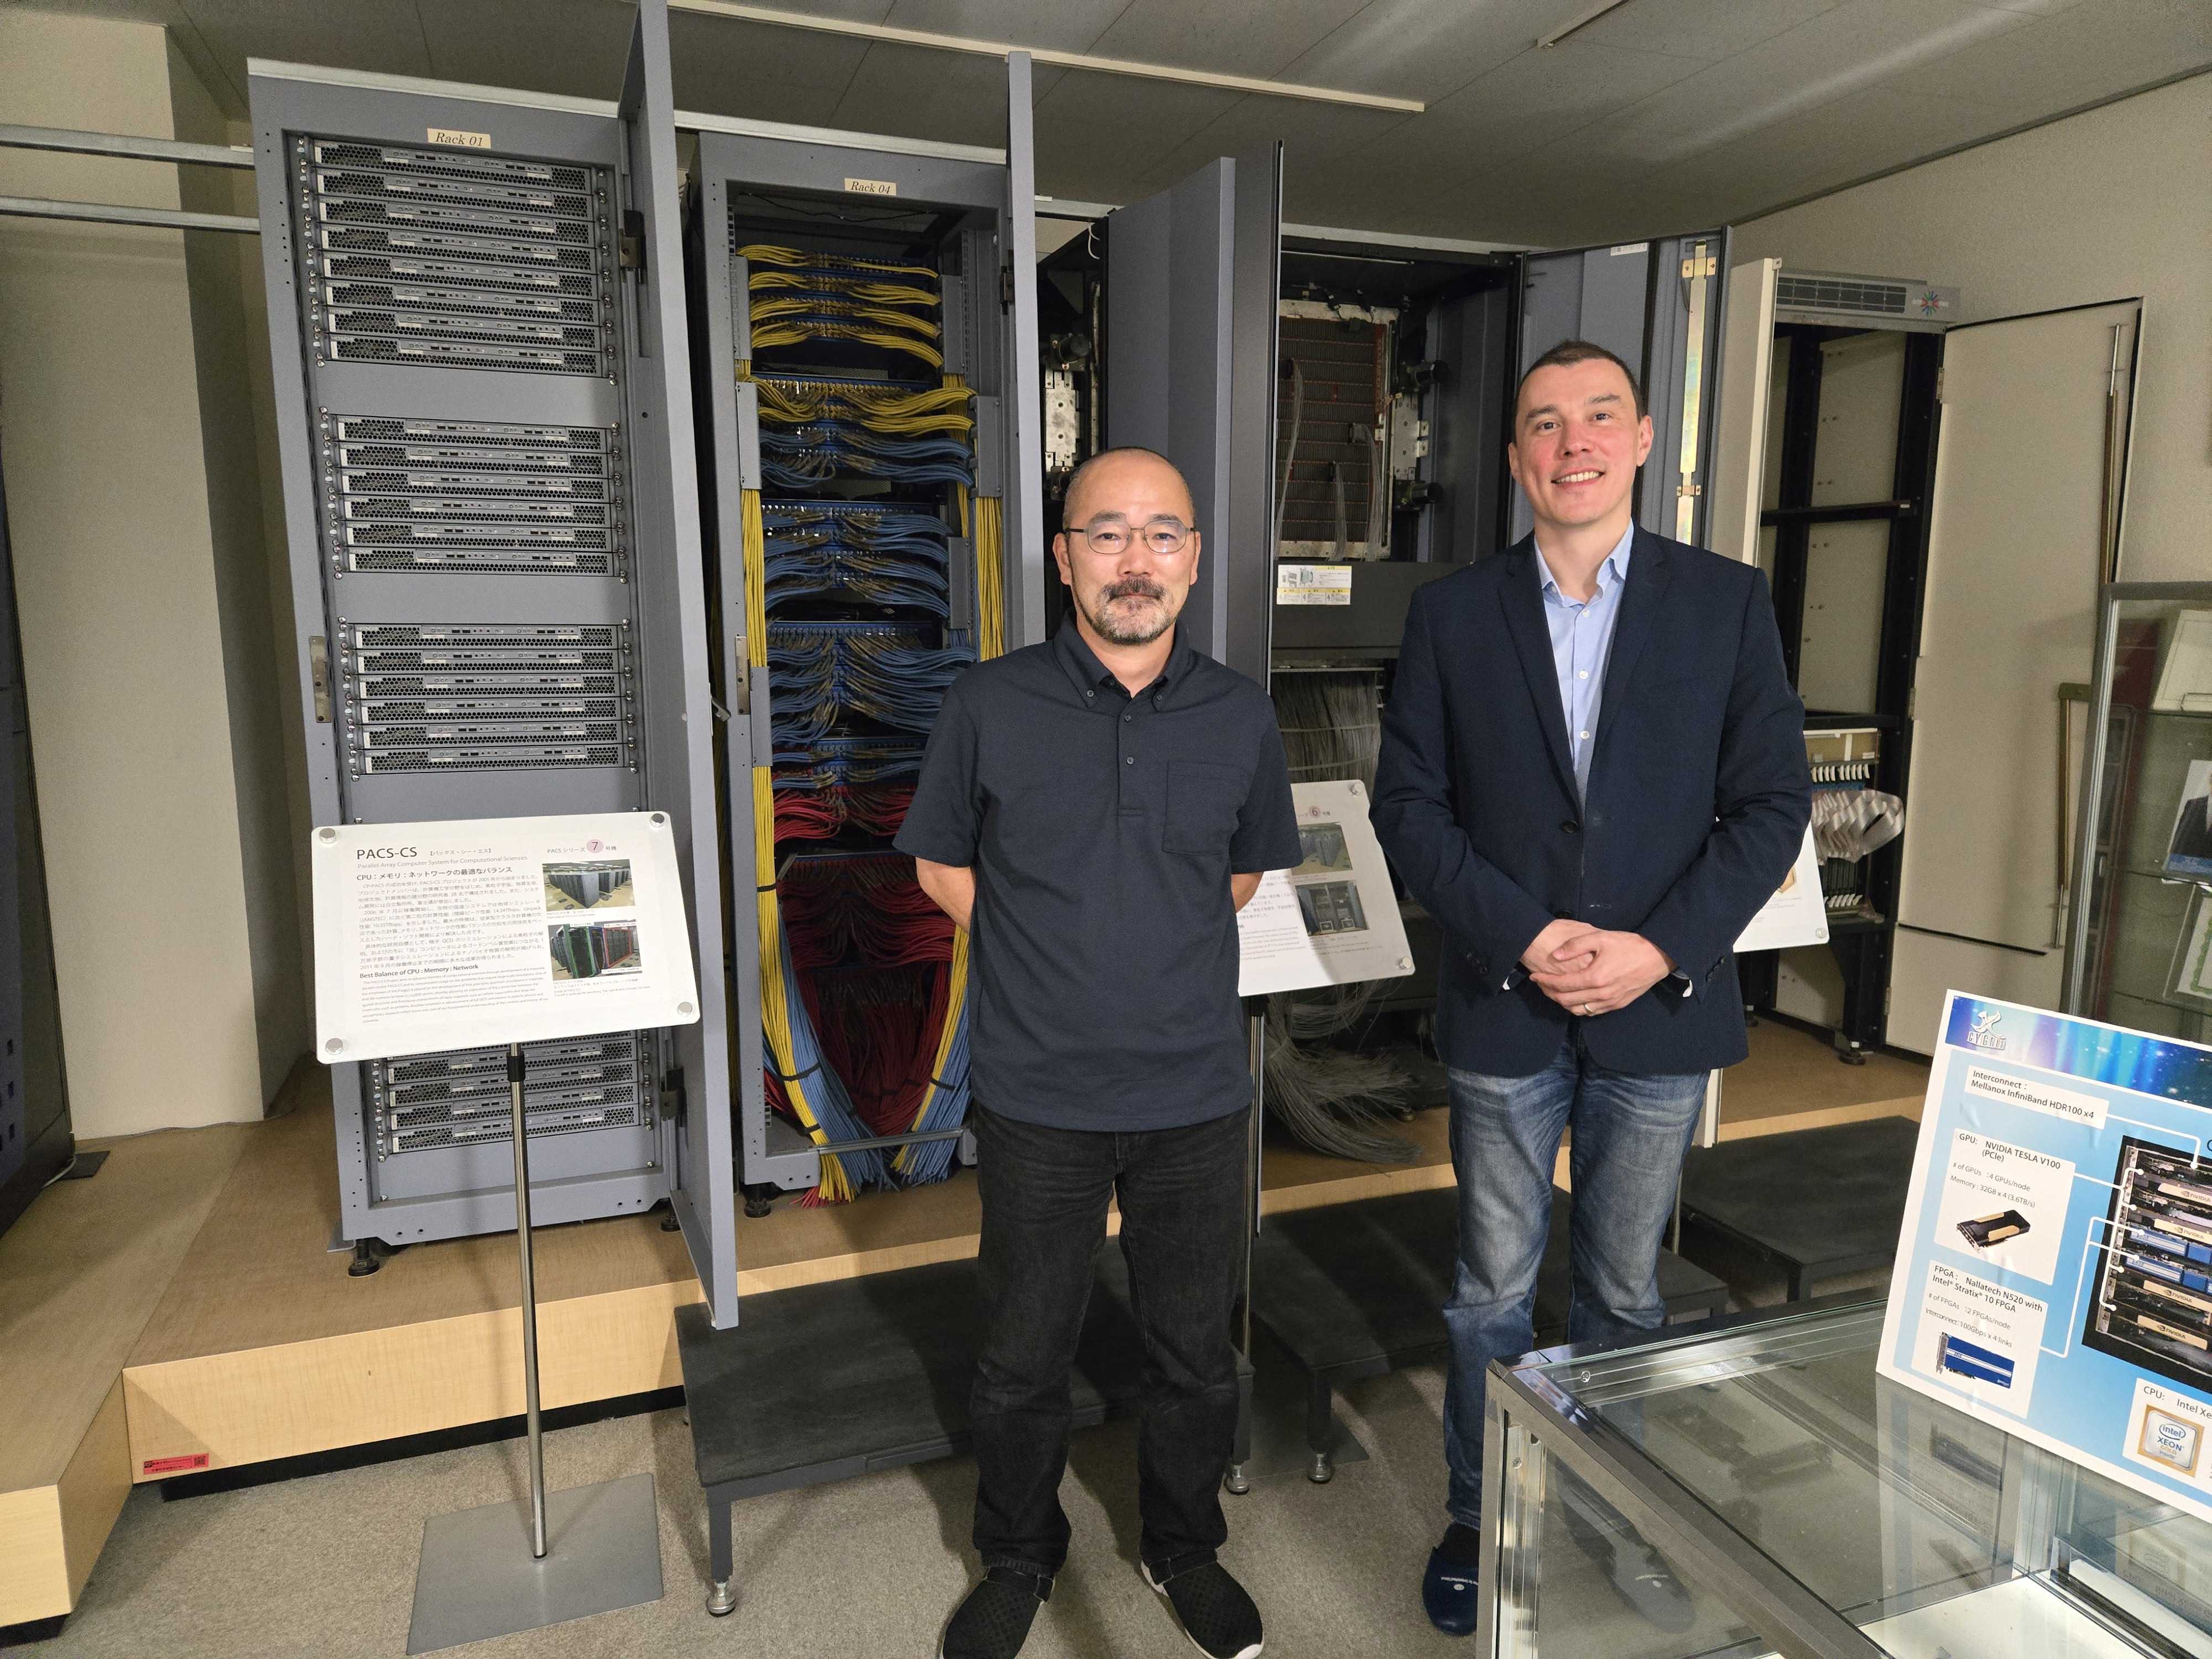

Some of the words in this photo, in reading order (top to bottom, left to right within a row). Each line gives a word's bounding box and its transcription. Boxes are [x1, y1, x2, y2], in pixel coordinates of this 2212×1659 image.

[435, 132, 465, 145] Rack
[469, 136, 482, 147] 01
[851, 181, 875, 192] Rack
[878, 185, 890, 194] 04
[1312, 807, 1318, 816] 6
[357, 847, 418, 859] PACS-CS
[591, 842, 598, 851] 7
[397, 859, 427, 868] Computer
[424, 966, 449, 974] Memory
[1973, 1070, 2022, 1090] Interconnect
[1971, 1079, 2006, 1095] Mellanox
[2007, 1089, 2048, 1107] InfiniBand
[2049, 1100, 2083, 1117] HDR100
[2084, 1109, 2095, 1119] x4
[1959, 1133, 1978, 1145] GPU:
[1985, 1141, 2012, 1155] NVIDIA
[2015, 1149, 2038, 1163] TESLA
[2041, 1157, 2061, 1170] V100
[1982, 1149, 2005, 1163] (PCIe)
[1965, 1165, 1981, 1176] GPUs
[1995, 1175, 2031, 1192] GPUs/node
[1950, 1175, 1976, 1190] Memory
[1979, 1185, 1996, 1196] 32GB
[2008, 1193, 2036, 1209] (3.6TB/s)
[1934, 1265, 1954, 1279] FPGA
[1965, 1276, 2001, 1296] Nallatech
[2003, 1291, 2023, 1305] N520
[2025, 1301, 2043, 1312] with
[1984, 1295, 1994, 1304] 10
[1995, 1298, 2016, 1313] FPGA
[1940, 1297, 1960, 1310] FPGAs
[1973, 1310, 2011, 1331] FPGAs/node
[1960, 1321, 1986, 1338] 100Gbps
[1997, 1336, 2013, 1348] links
[2143, 1386, 2166, 1401] CPU:
[2177, 1399, 2199, 1413] Intel
[2162, 1424, 2184, 1438] intel
[2157, 1436, 2182, 1452] XEON
[2160, 1445, 2177, 1455] GOLD
